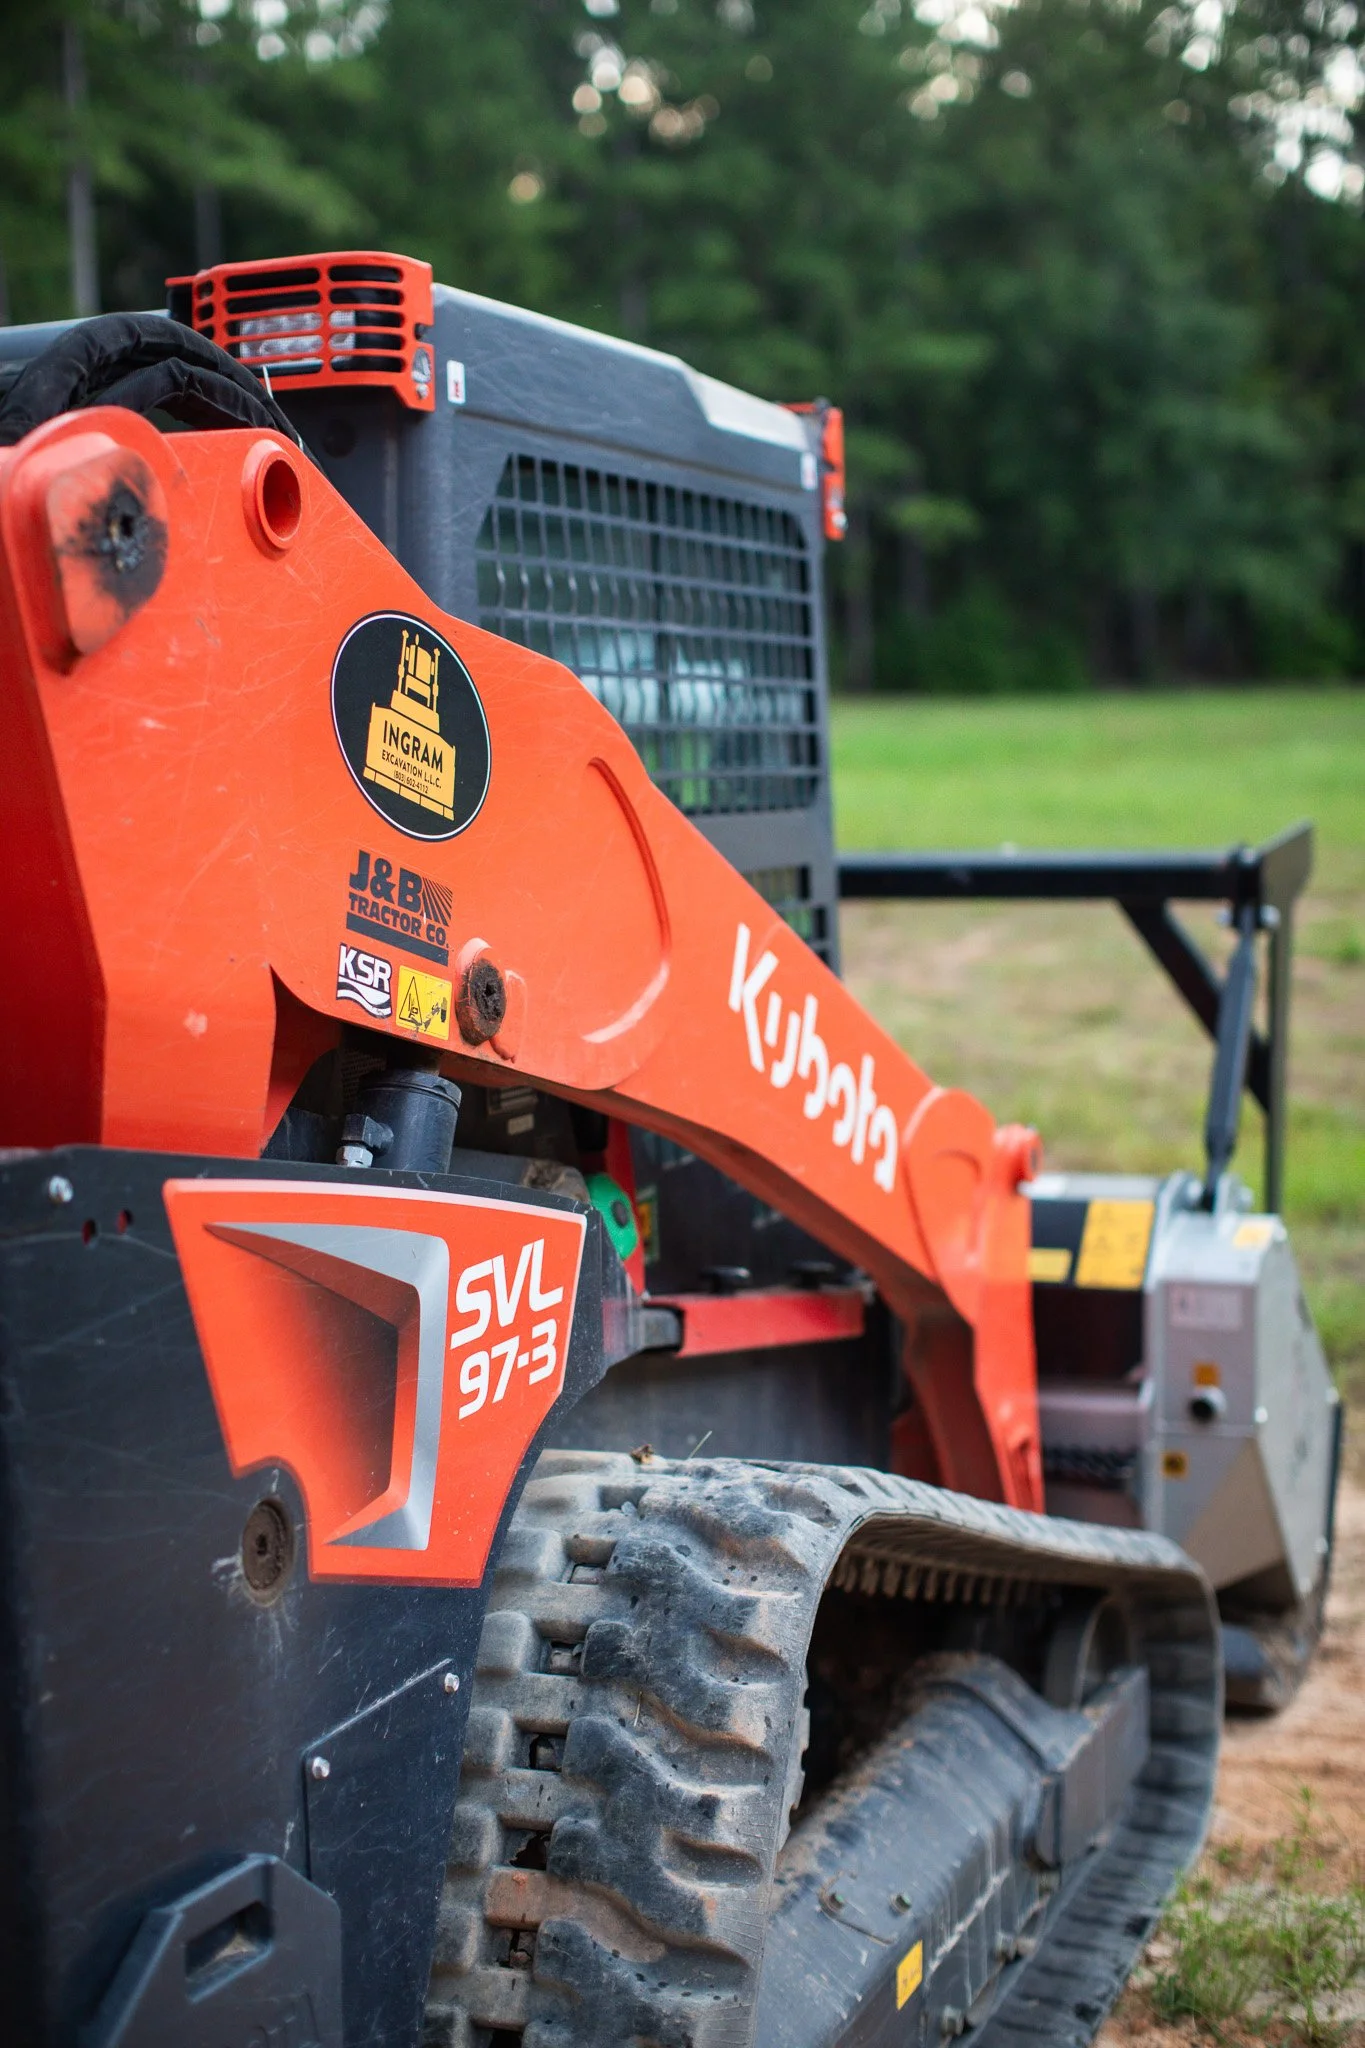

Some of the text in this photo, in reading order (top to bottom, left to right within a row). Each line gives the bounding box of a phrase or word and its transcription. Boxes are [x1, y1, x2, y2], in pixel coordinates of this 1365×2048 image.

[382, 749, 442, 789] EXCAVATION L.L.C.
[383, 720, 443, 773] INGRAM
[349, 849, 423, 913] J&B
[348, 891, 449, 949] TRACTOR CO.
[338, 944, 392, 993] KSR
[728, 922, 899, 1193] Kubota
[450, 1238, 564, 1350] SVL
[458, 1318, 558, 1421] 97-3
